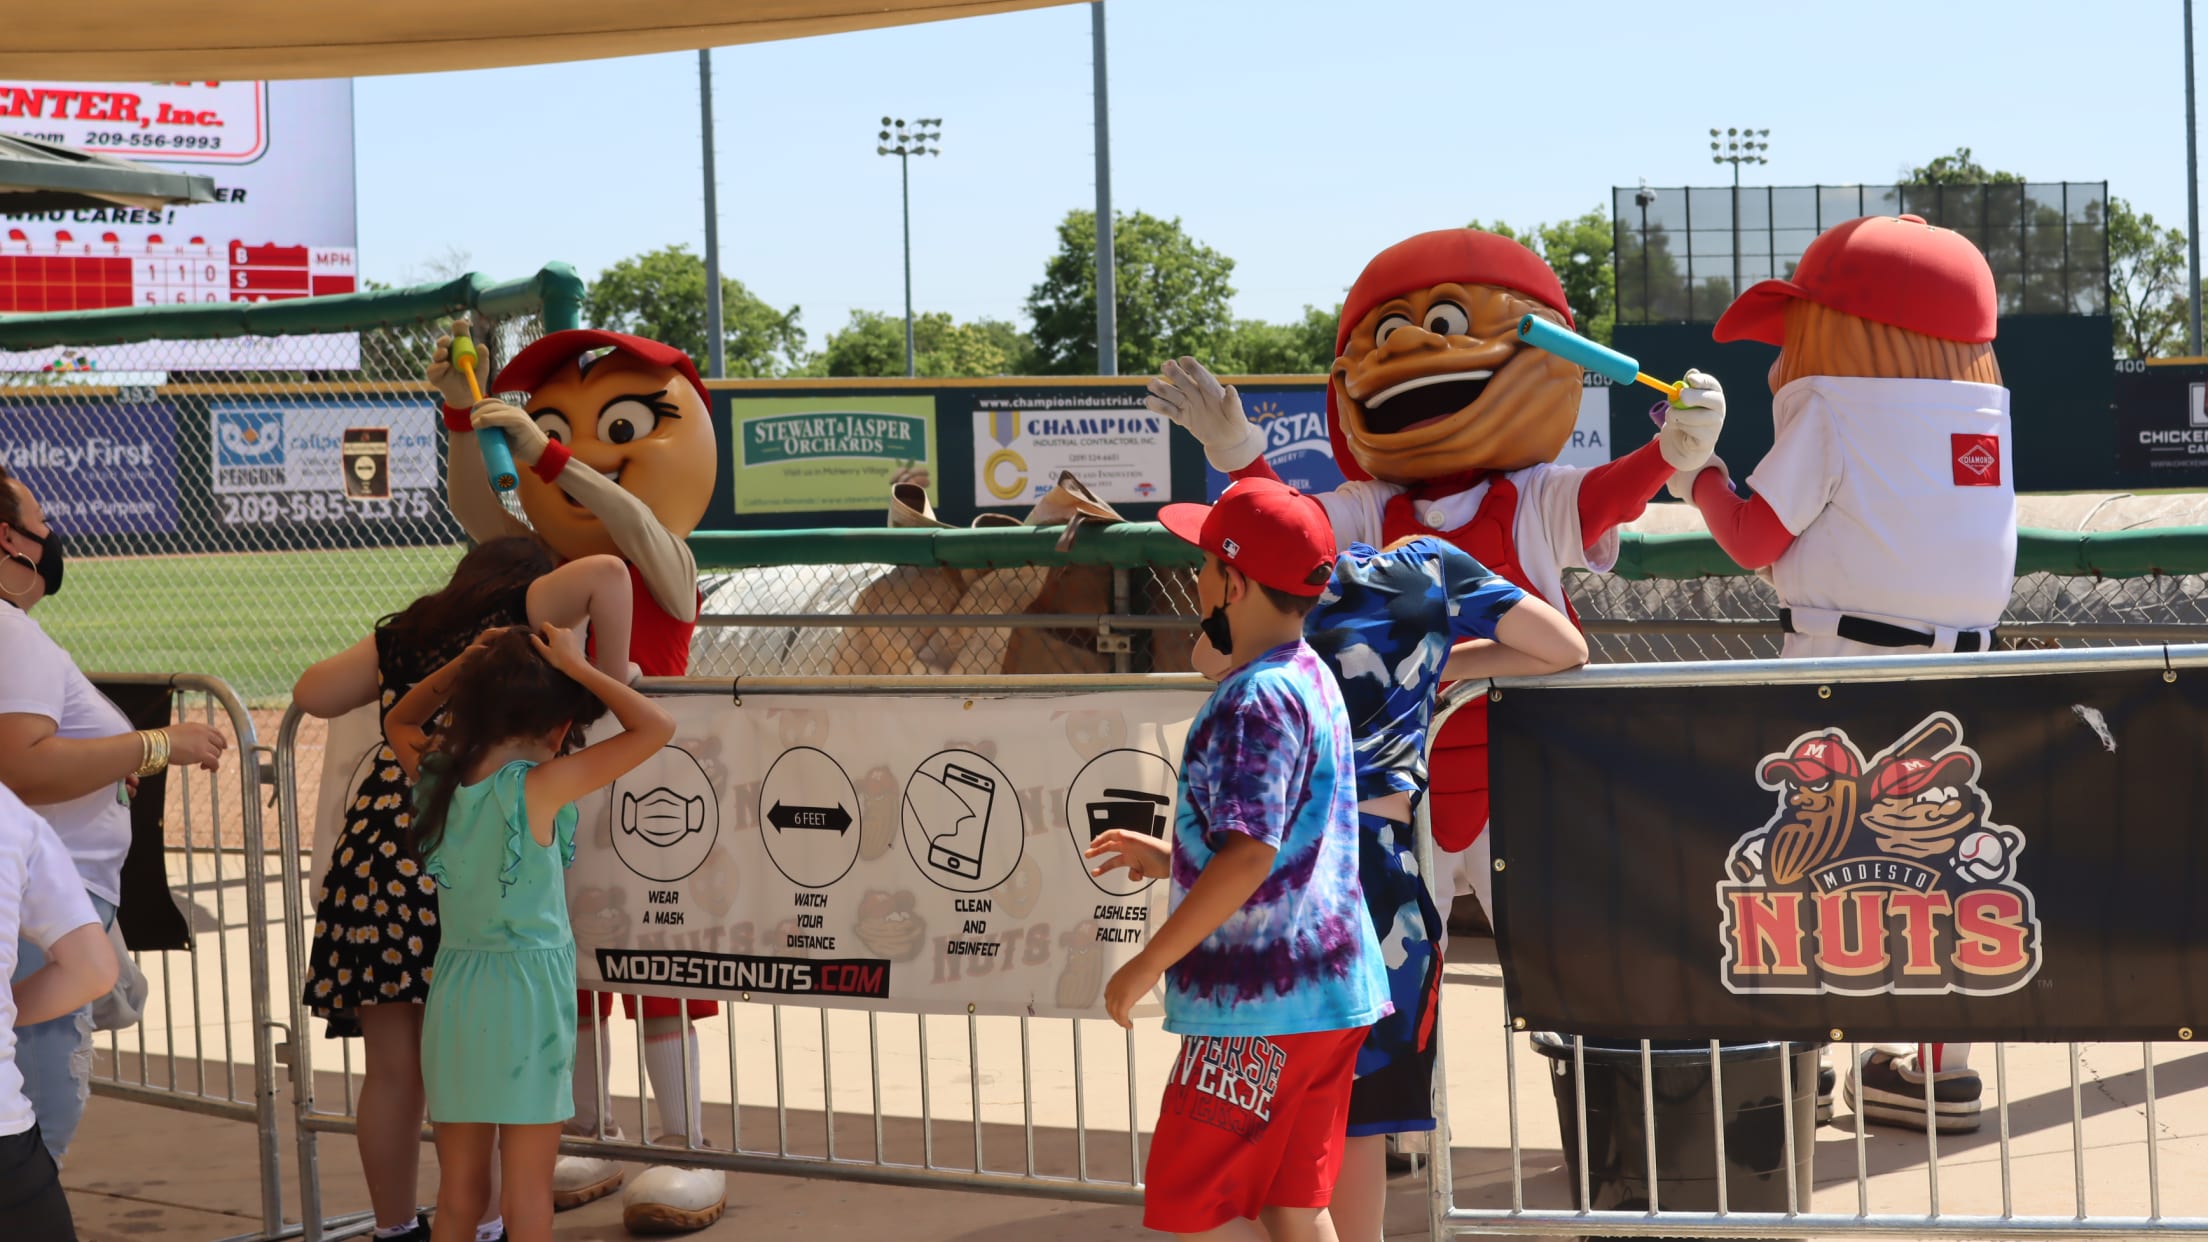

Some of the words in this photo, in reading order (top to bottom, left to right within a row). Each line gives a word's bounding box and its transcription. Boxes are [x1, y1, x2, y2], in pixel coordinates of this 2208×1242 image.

[156, 102, 225, 127] Inc.
[85, 131, 222, 149] 209-556-9993
[235, 247, 249, 264] B
[316, 252, 351, 266] MPH
[149, 265, 156, 281] 1
[179, 265, 186, 281] 1
[205, 265, 216, 281] 0
[235, 271, 249, 288] S
[2114, 360, 2146, 373] 400
[1583, 373, 1614, 386] 400
[979, 396, 1149, 410] www.championindustrial.c
[1027, 417, 1160, 436] CHAMPION
[784, 437, 884, 455] ORCHARDS
[1033, 438, 1078, 447] INDUSTRIAL
[2187, 444, 2208, 454] CA
[218, 468, 287, 487] PENGUIN
[1803, 744, 1828, 759] M
[1900, 760, 1926, 771] M
[794, 811, 802, 825] 6
[802, 811, 827, 826] FEET
[1823, 863, 1928, 889] MODESTO
[648, 890, 679, 904] WEAR
[794, 892, 828, 908] WATCH
[954, 899, 992, 913] CLEAN
[1093, 905, 1147, 921] CASHLESS
[642, 911, 651, 924] A
[654, 911, 685, 925] MASK
[796, 914, 824, 929] YOUR
[962, 920, 986, 934] AND
[1095, 927, 1142, 943] FACILITY
[1728, 889, 2030, 977] NUTS
[786, 934, 836, 950] DISTANCE
[947, 940, 1000, 957] DISINFECT
[604, 954, 884, 993] MODESTONUTS.COM
